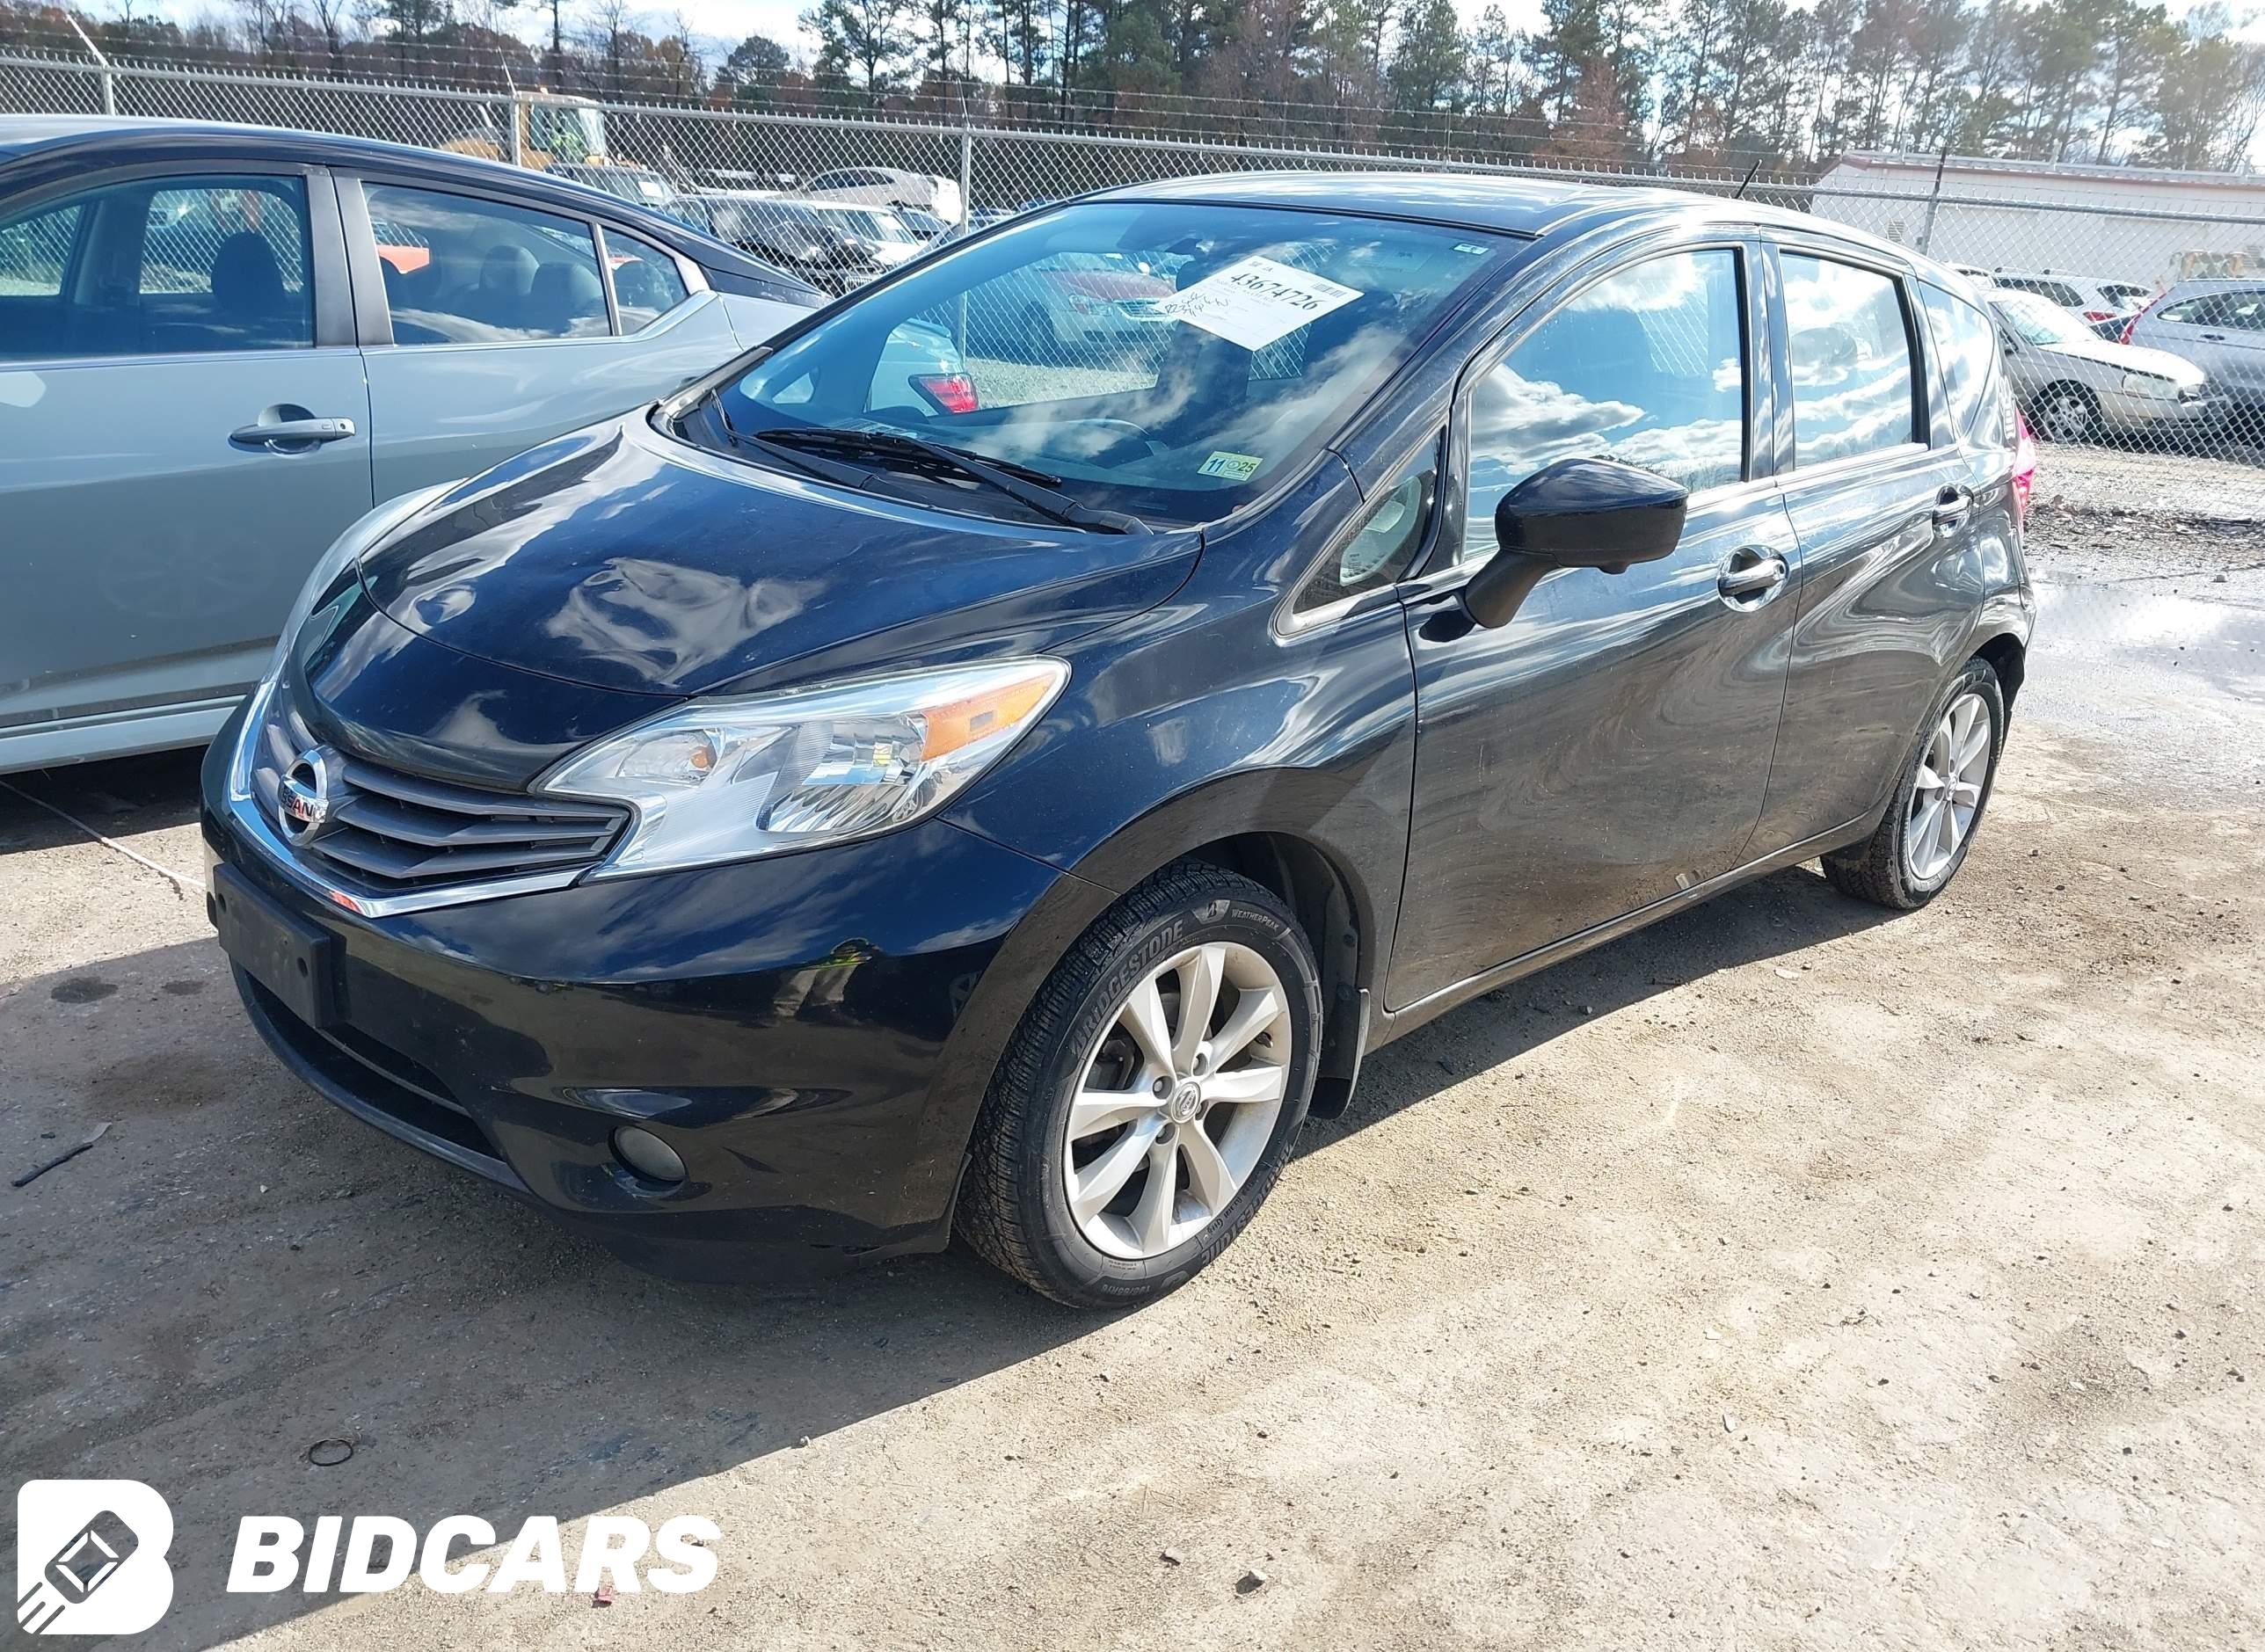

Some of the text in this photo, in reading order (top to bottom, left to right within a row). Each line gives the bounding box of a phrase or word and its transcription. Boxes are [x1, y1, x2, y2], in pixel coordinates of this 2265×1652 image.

[1230, 272, 1325, 311] 43674726
[1206, 458, 1256, 473] 11 25
[1070, 919, 1184, 1057] BRIDGESTONE
